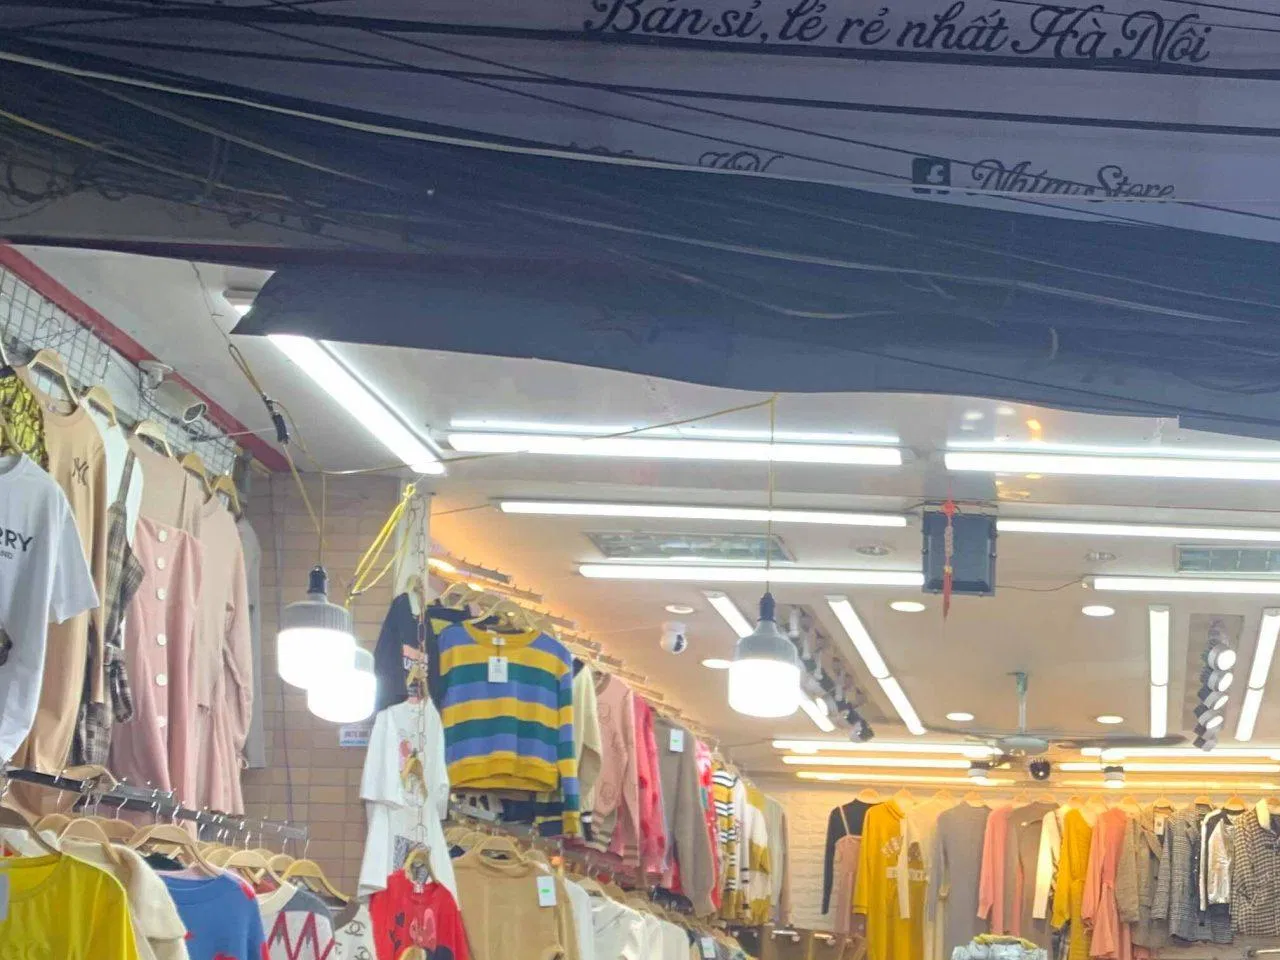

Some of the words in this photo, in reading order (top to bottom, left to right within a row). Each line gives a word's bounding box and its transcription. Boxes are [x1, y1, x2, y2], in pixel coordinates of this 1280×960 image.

[836, 7, 891, 46] rẻ
[896, 0, 1010, 53] nhất
[1011, 4, 1107, 61] Hà
